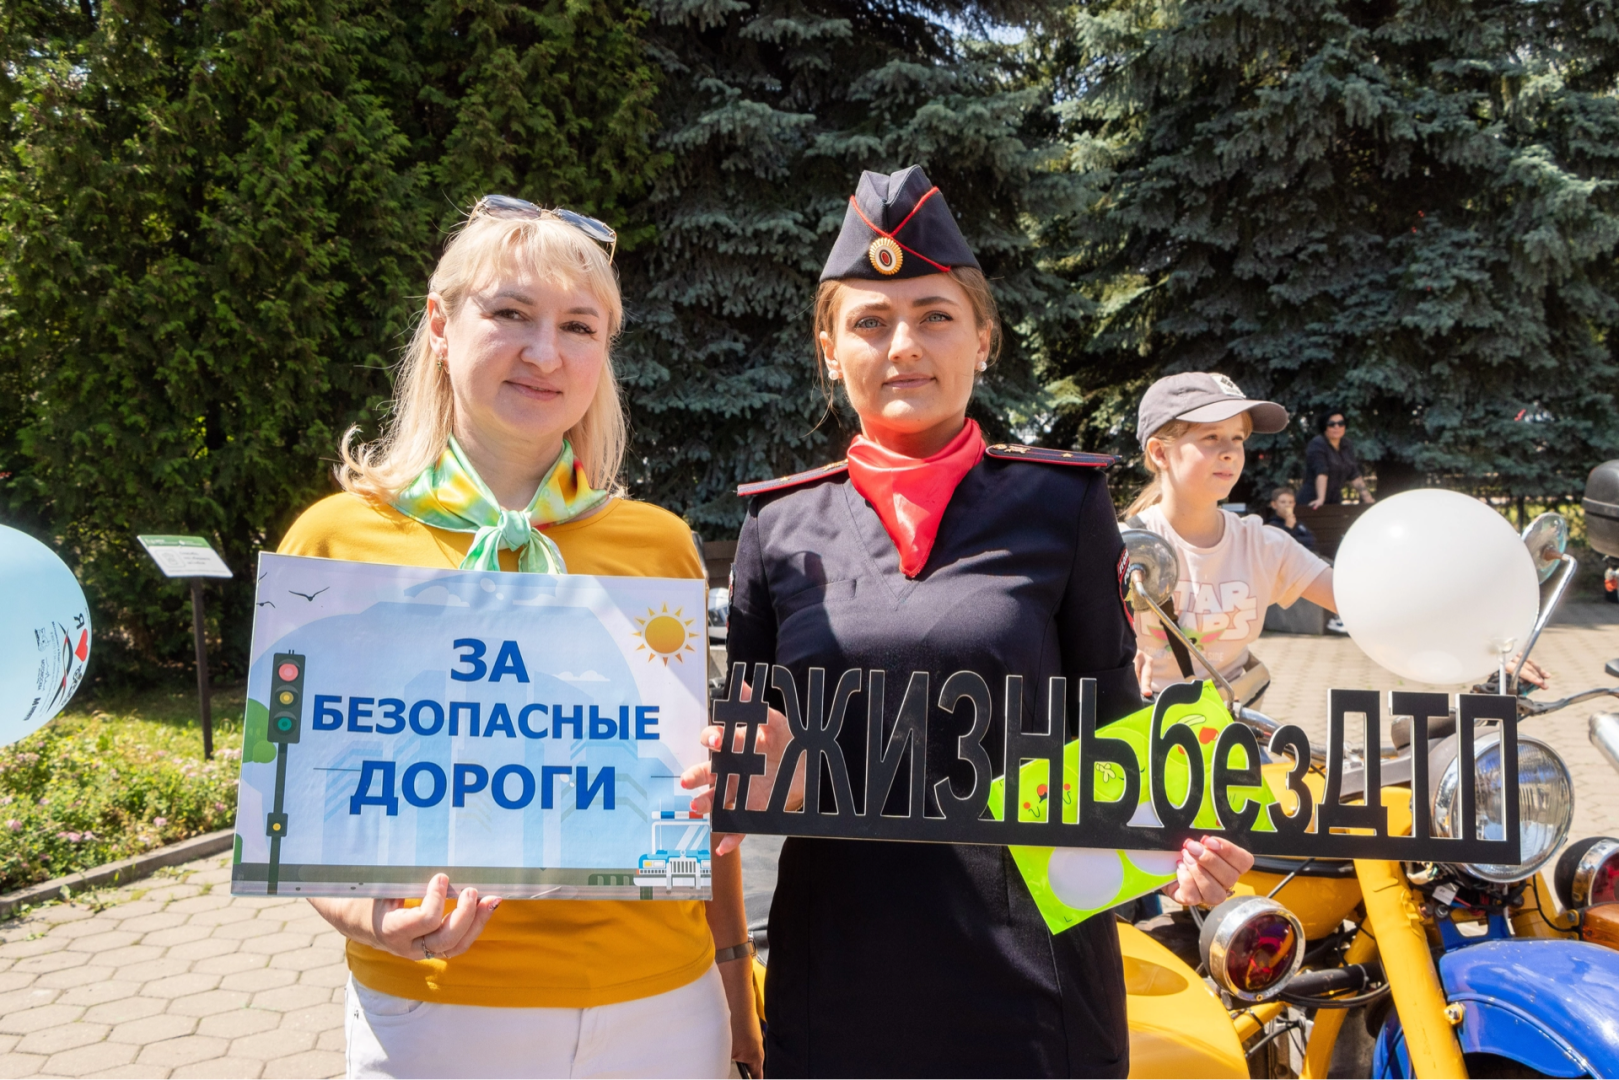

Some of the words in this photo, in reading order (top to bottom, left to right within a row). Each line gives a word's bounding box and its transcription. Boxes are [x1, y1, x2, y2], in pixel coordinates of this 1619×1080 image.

[1172, 579, 1257, 615] TAR
[450, 637, 530, 683] ЗА
[312, 694, 660, 741] БЕЗОПАСНЫЕ
[711, 661, 1521, 864] #ЖИЗНЬбезДТП
[349, 760, 616, 816] ДОРОГИ
